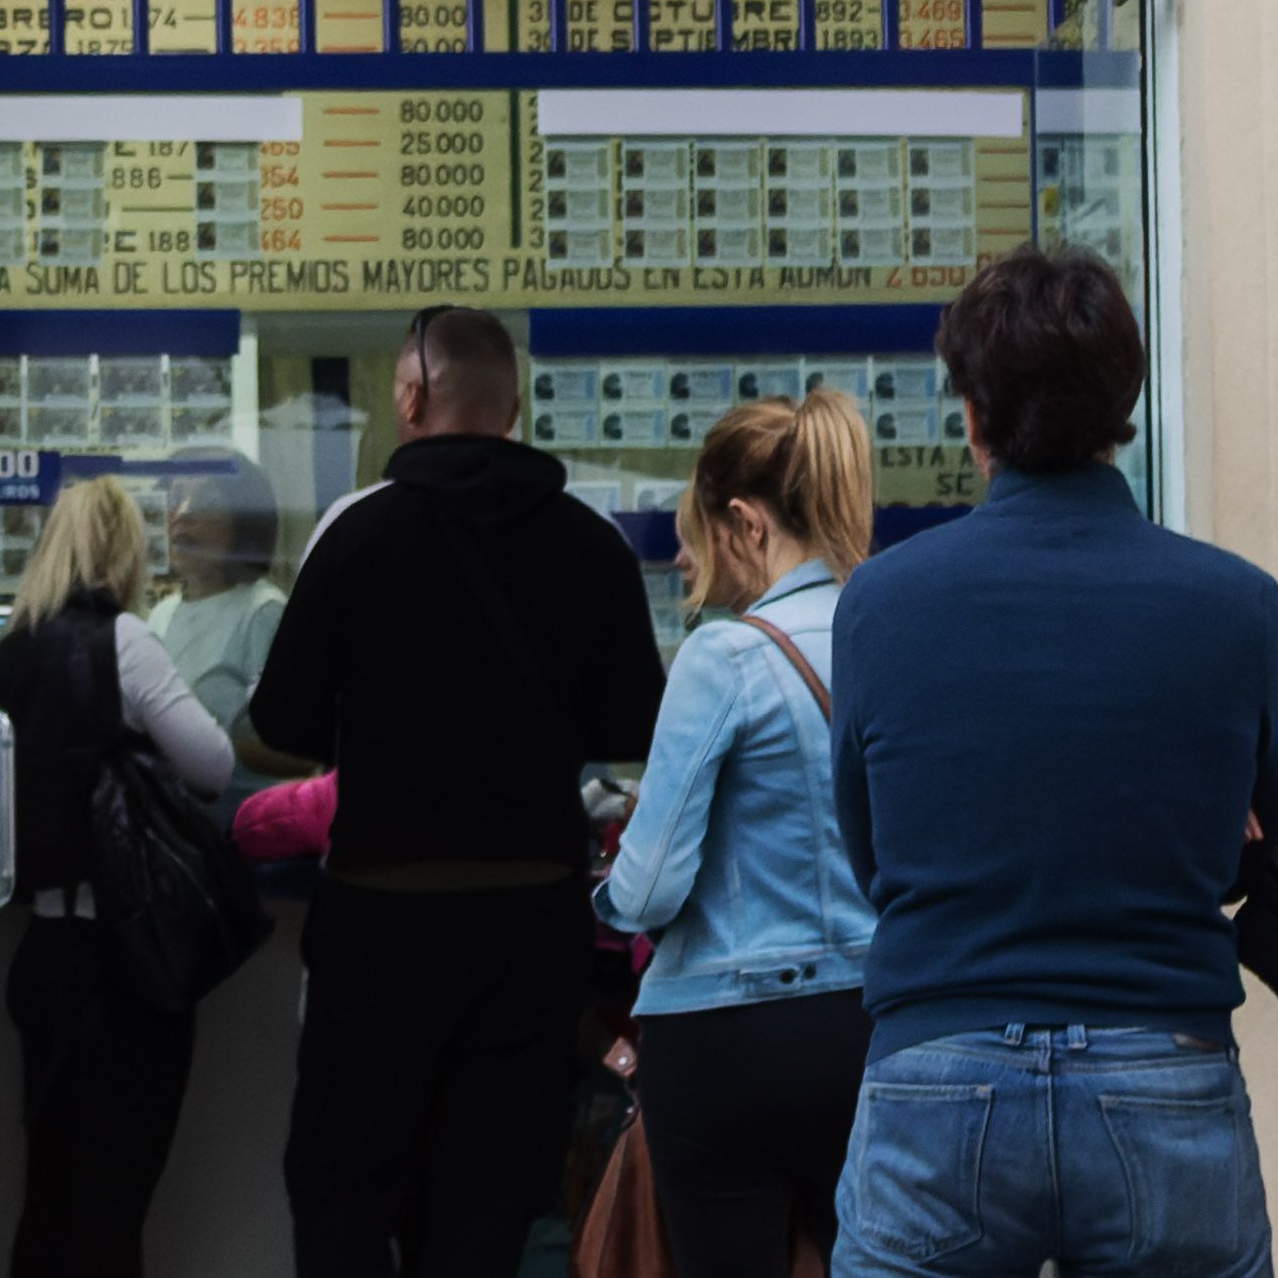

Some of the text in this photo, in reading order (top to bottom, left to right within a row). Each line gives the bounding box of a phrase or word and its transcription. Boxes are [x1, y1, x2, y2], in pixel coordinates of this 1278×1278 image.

[25, 262, 100, 295] SUMA
[113, 263, 149, 295] DE
[163, 261, 217, 295] LOS
[230, 259, 350, 294] PREMIOS
[362, 258, 490, 293] MAYORES
